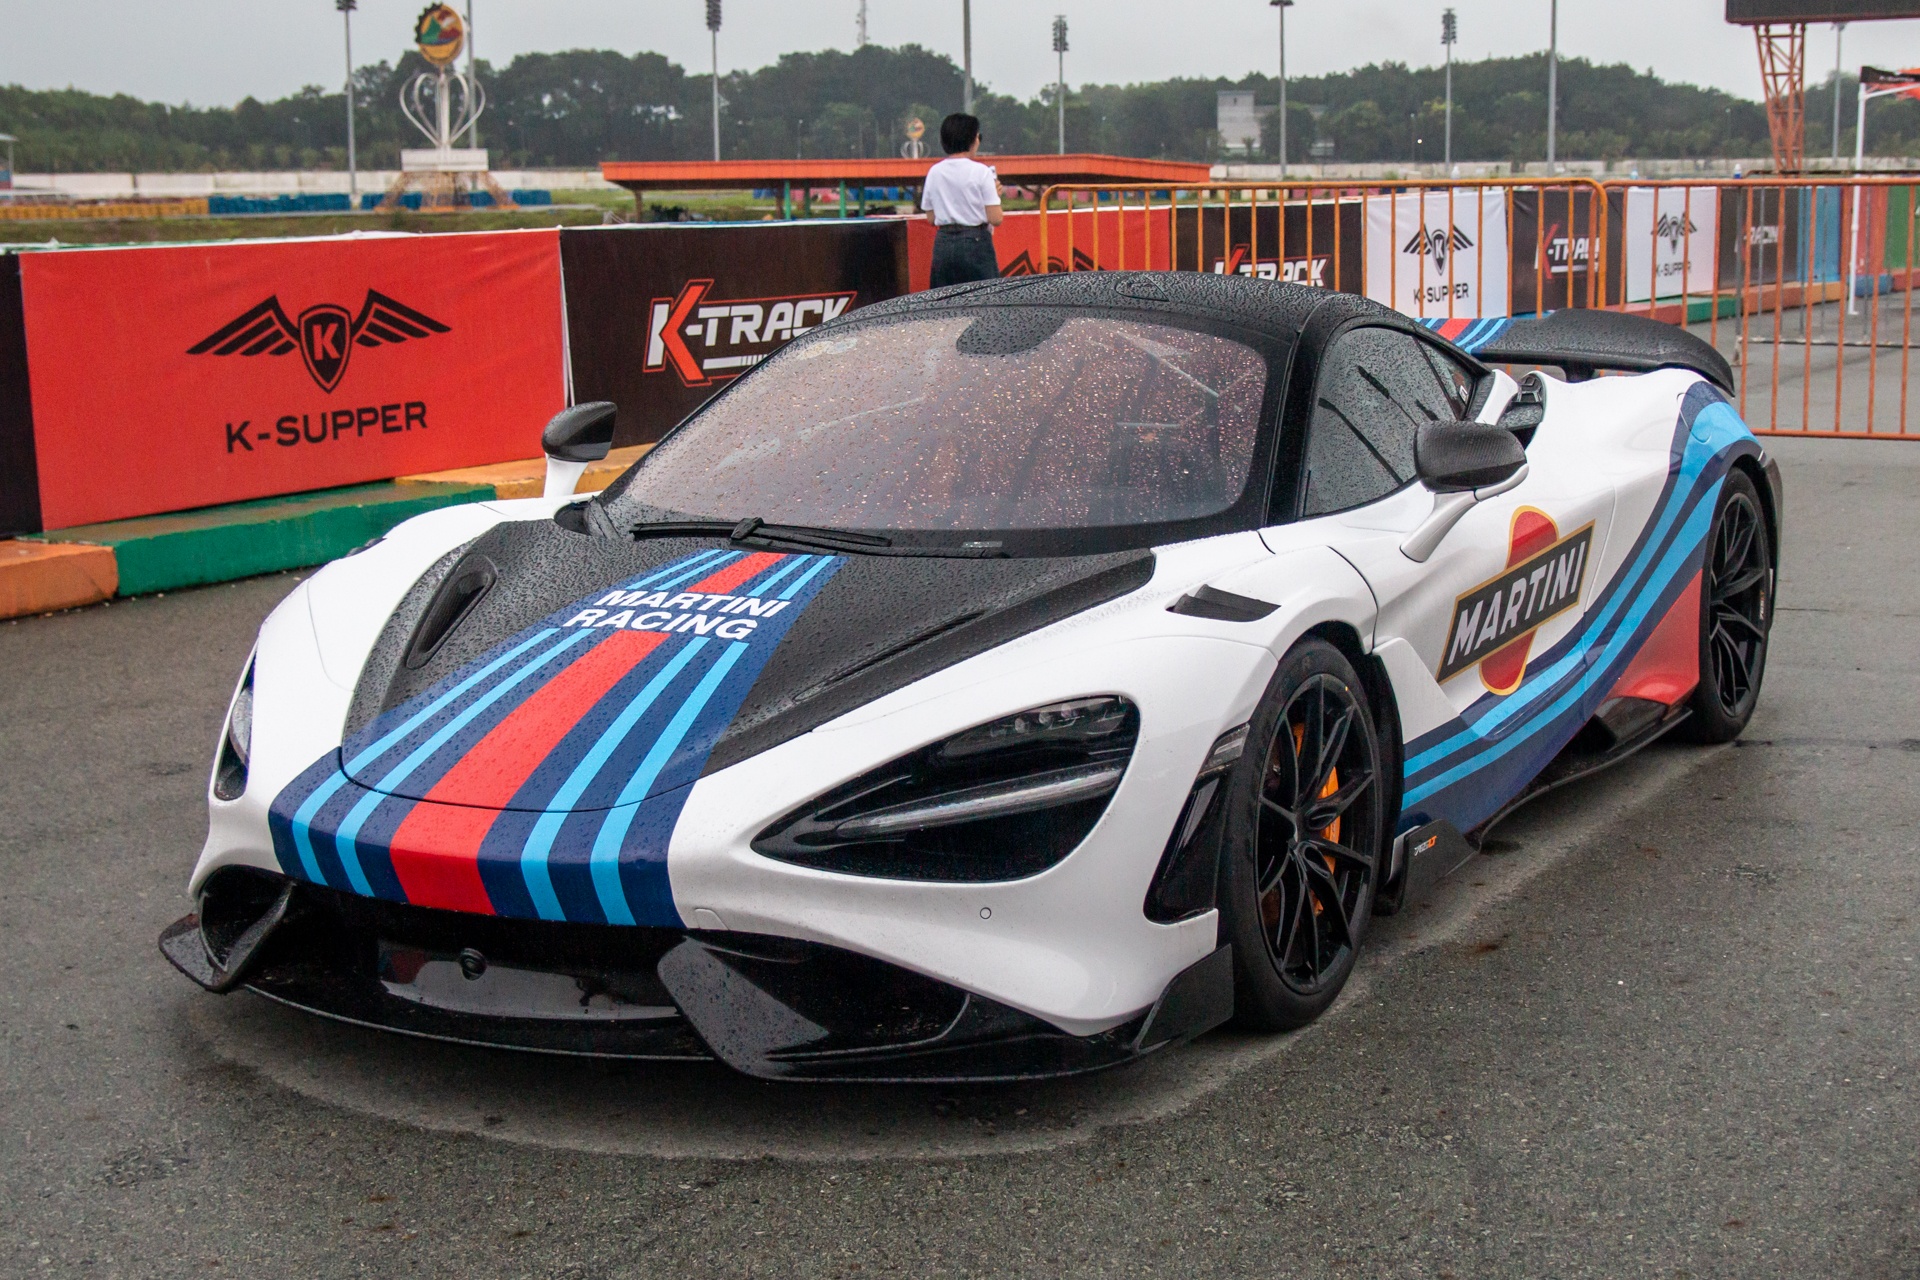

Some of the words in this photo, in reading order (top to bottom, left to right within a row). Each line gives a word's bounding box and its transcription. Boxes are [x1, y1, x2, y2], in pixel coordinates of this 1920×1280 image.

[1214, 248, 1327, 287] TRACK
[1413, 282, 1470, 305] K-SUPER
[312, 322, 341, 361] K
[225, 401, 428, 454] K-SUPPER
[593, 590, 791, 618] MARTINI
[1446, 540, 1587, 667] MARTINI
[562, 608, 759, 640] RACING
